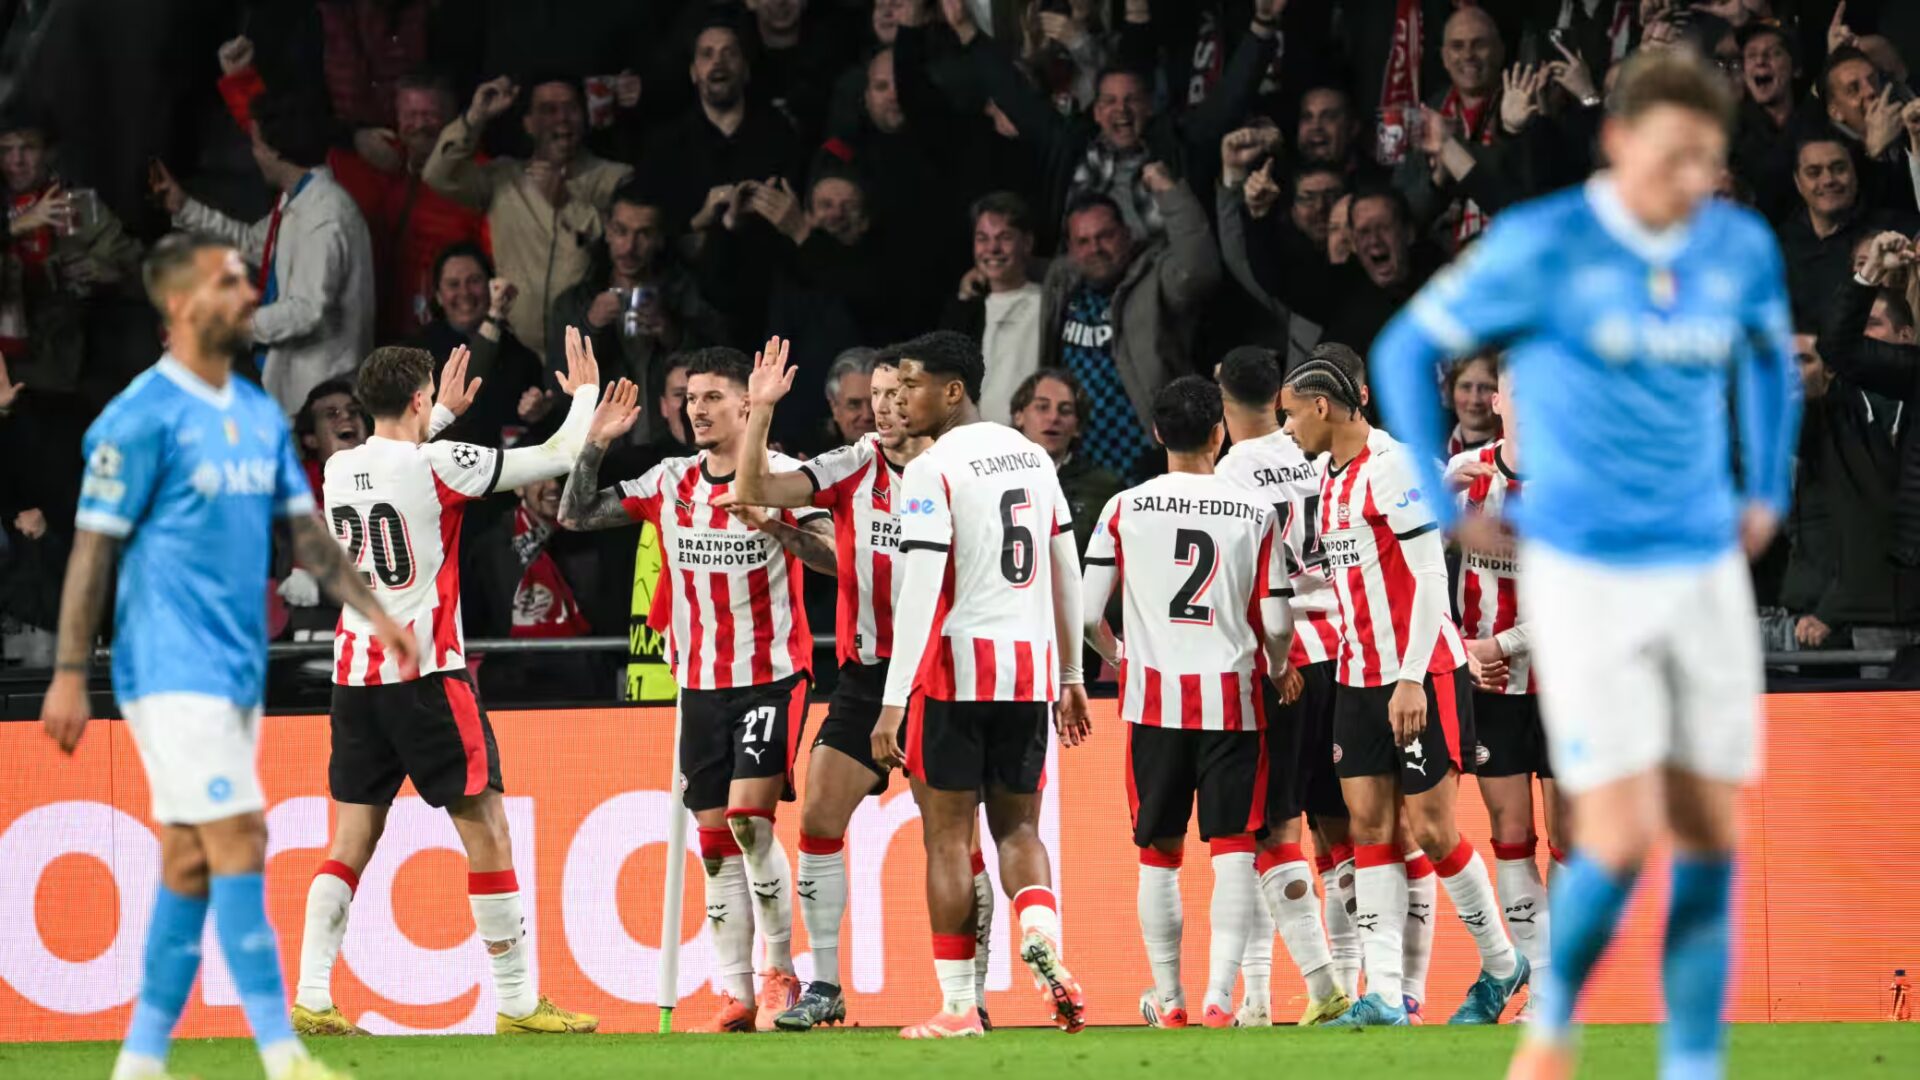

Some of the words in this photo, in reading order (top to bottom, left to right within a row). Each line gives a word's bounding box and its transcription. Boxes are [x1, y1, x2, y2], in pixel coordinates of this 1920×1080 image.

[969, 452, 1041, 477] FLAMINGO
[1254, 463, 1318, 487] SAIBARI
[354, 473, 373, 491] TIL
[1133, 496, 1264, 526] SALAH-EDDINE
[678, 538, 766, 552] BRAINPORT
[1000, 488, 1036, 589] 6
[678, 551, 768, 566] EINDHOVEN
[1169, 528, 1219, 626] 2
[742, 706, 776, 743] 27
[1505, 902, 1534, 914] PSV
